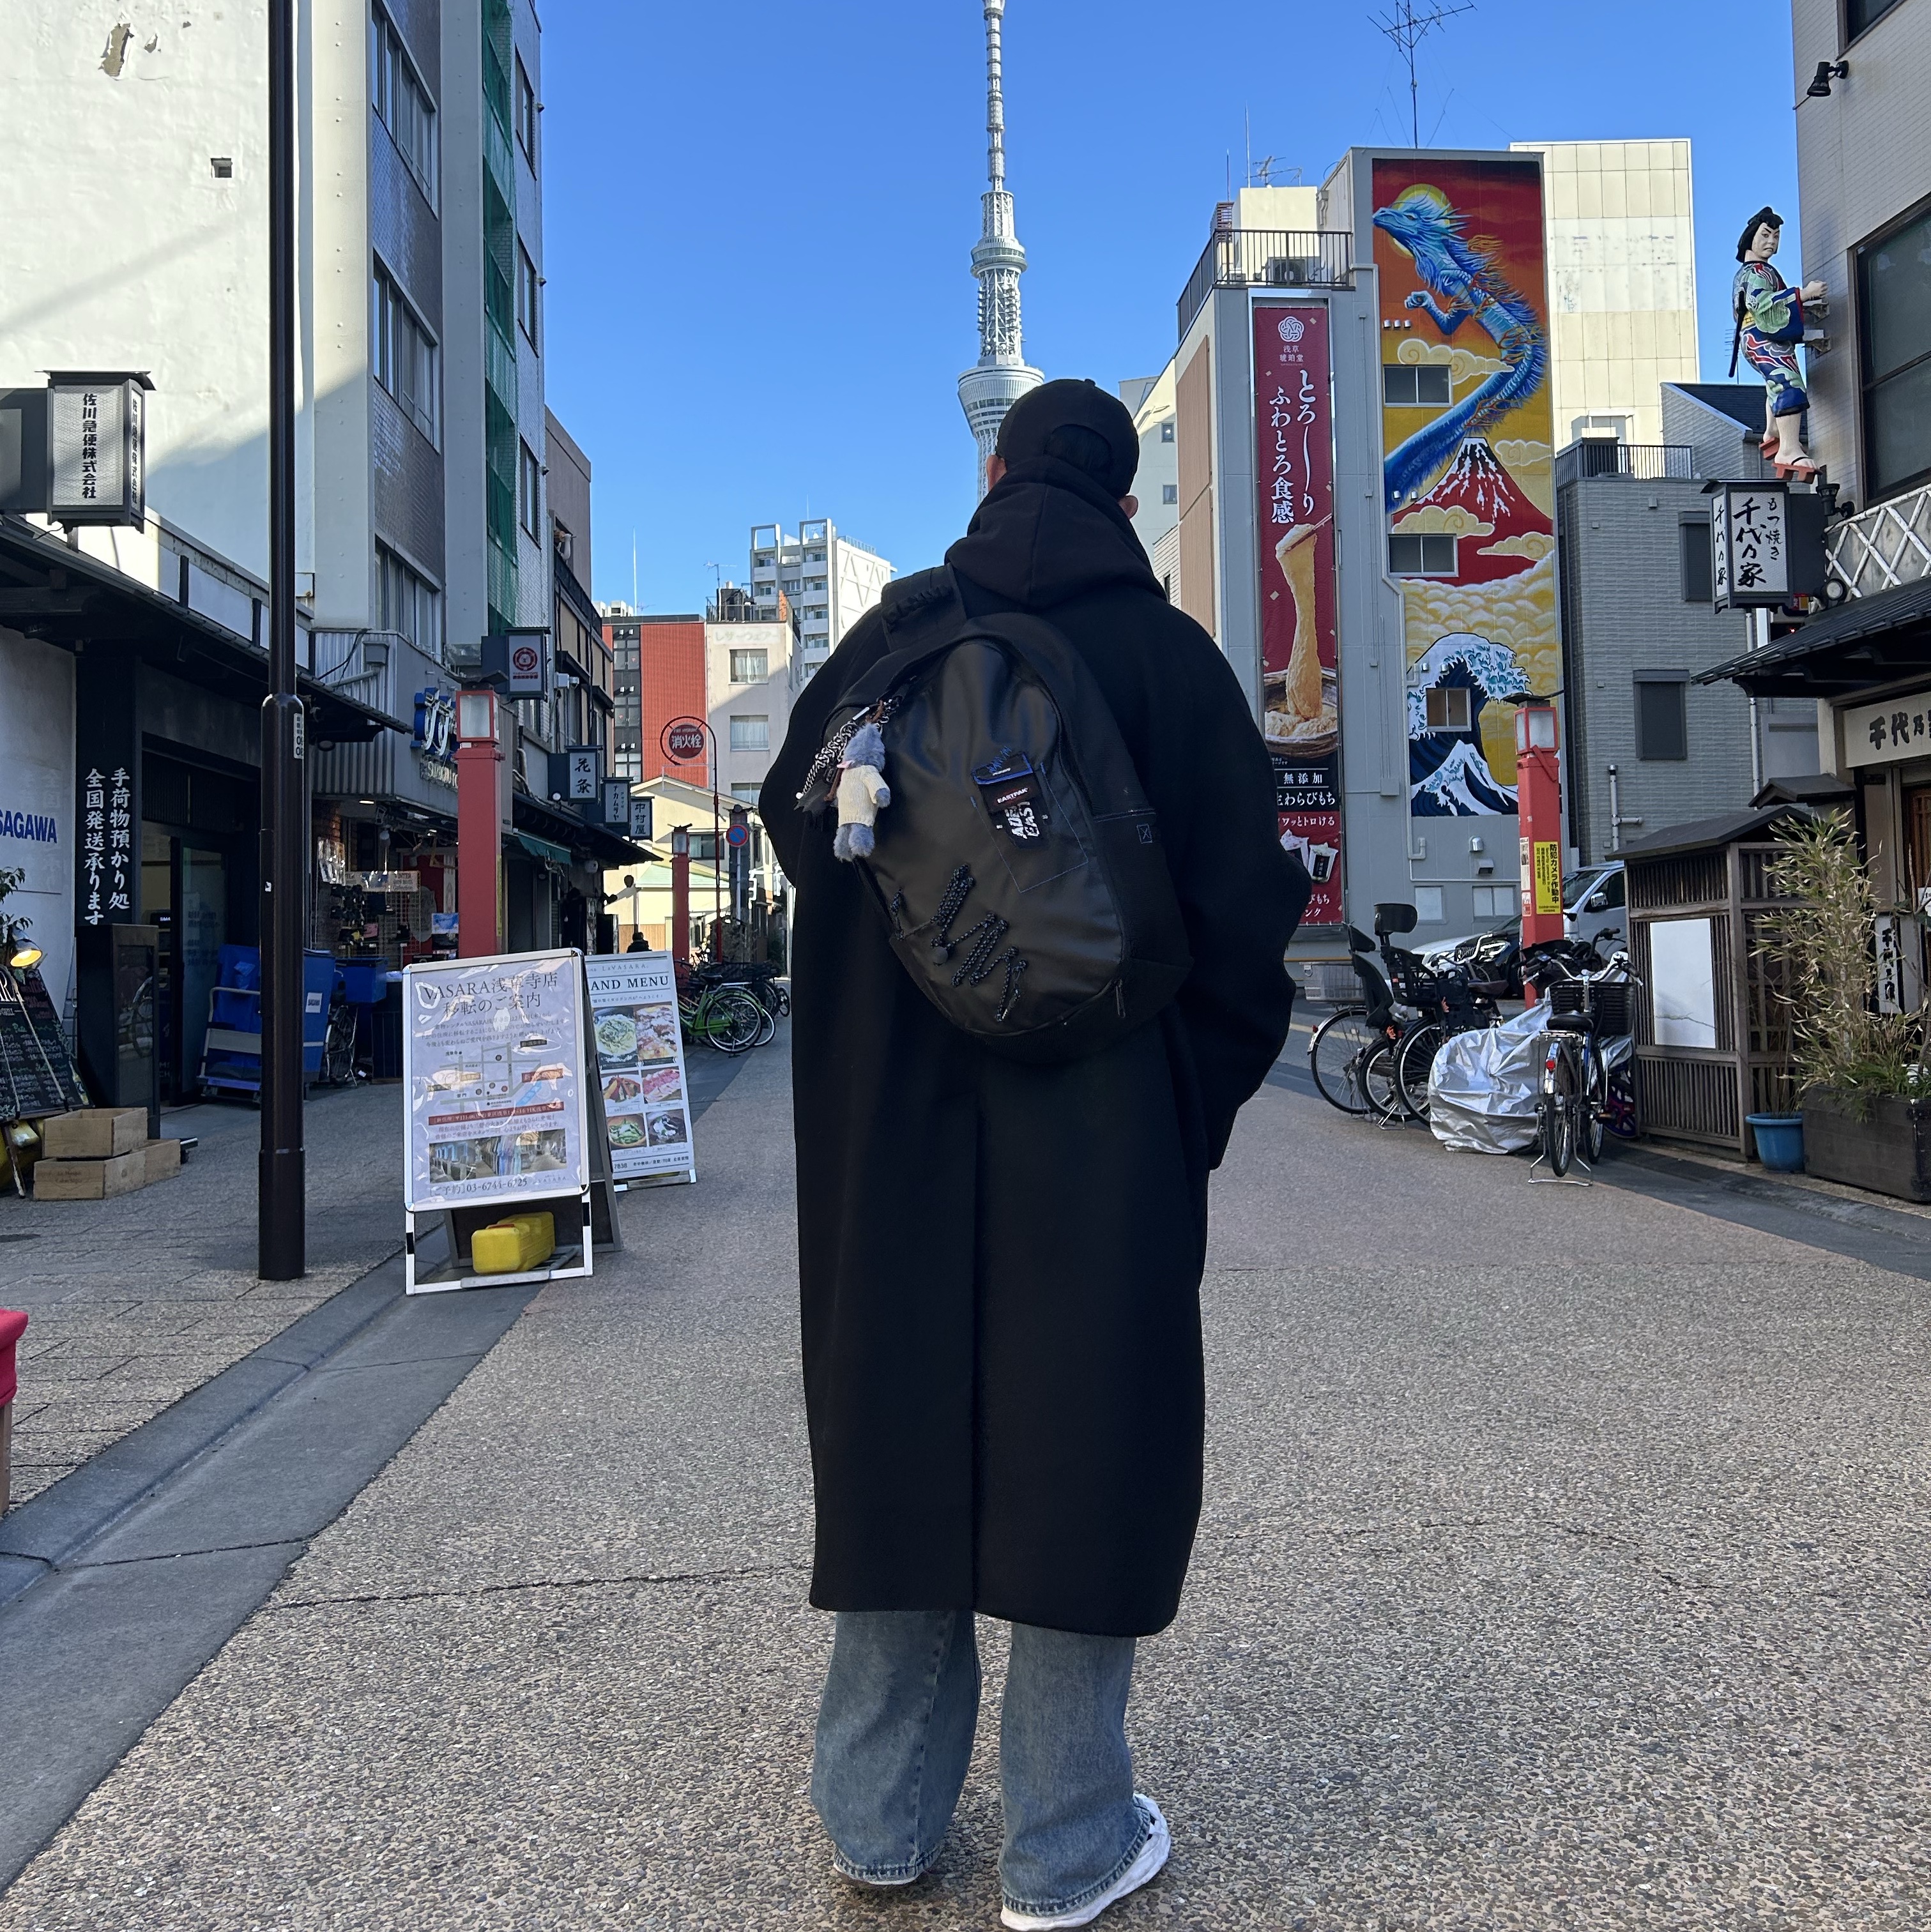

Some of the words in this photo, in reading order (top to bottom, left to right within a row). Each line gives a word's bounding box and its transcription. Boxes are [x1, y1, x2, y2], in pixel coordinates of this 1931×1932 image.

[82, 393, 98, 499] 佐川急便株式会社
[1269, 386, 1294, 524] ふわとろ食感
[1732, 496, 1767, 588] 千代乃家
[1765, 498, 1783, 561] もつ焼き
[671, 734, 702, 750] 消火栓
[996, 786, 1030, 804] EASTPAK
[1283, 772, 1323, 785] 無添加
[108, 766, 131, 910] 手荷物預かり処
[634, 803, 646, 835] 中村屋
[1278, 816, 1336, 827] ワッとトロける
[84, 768, 106, 925] 全国発送承ります
[1549, 844, 1559, 904] 防犯カメラ作動中
[443, 992, 540, 1015] 移転のご案内
[590, 979, 622, 991] AND
[627, 975, 669, 989] MENU
